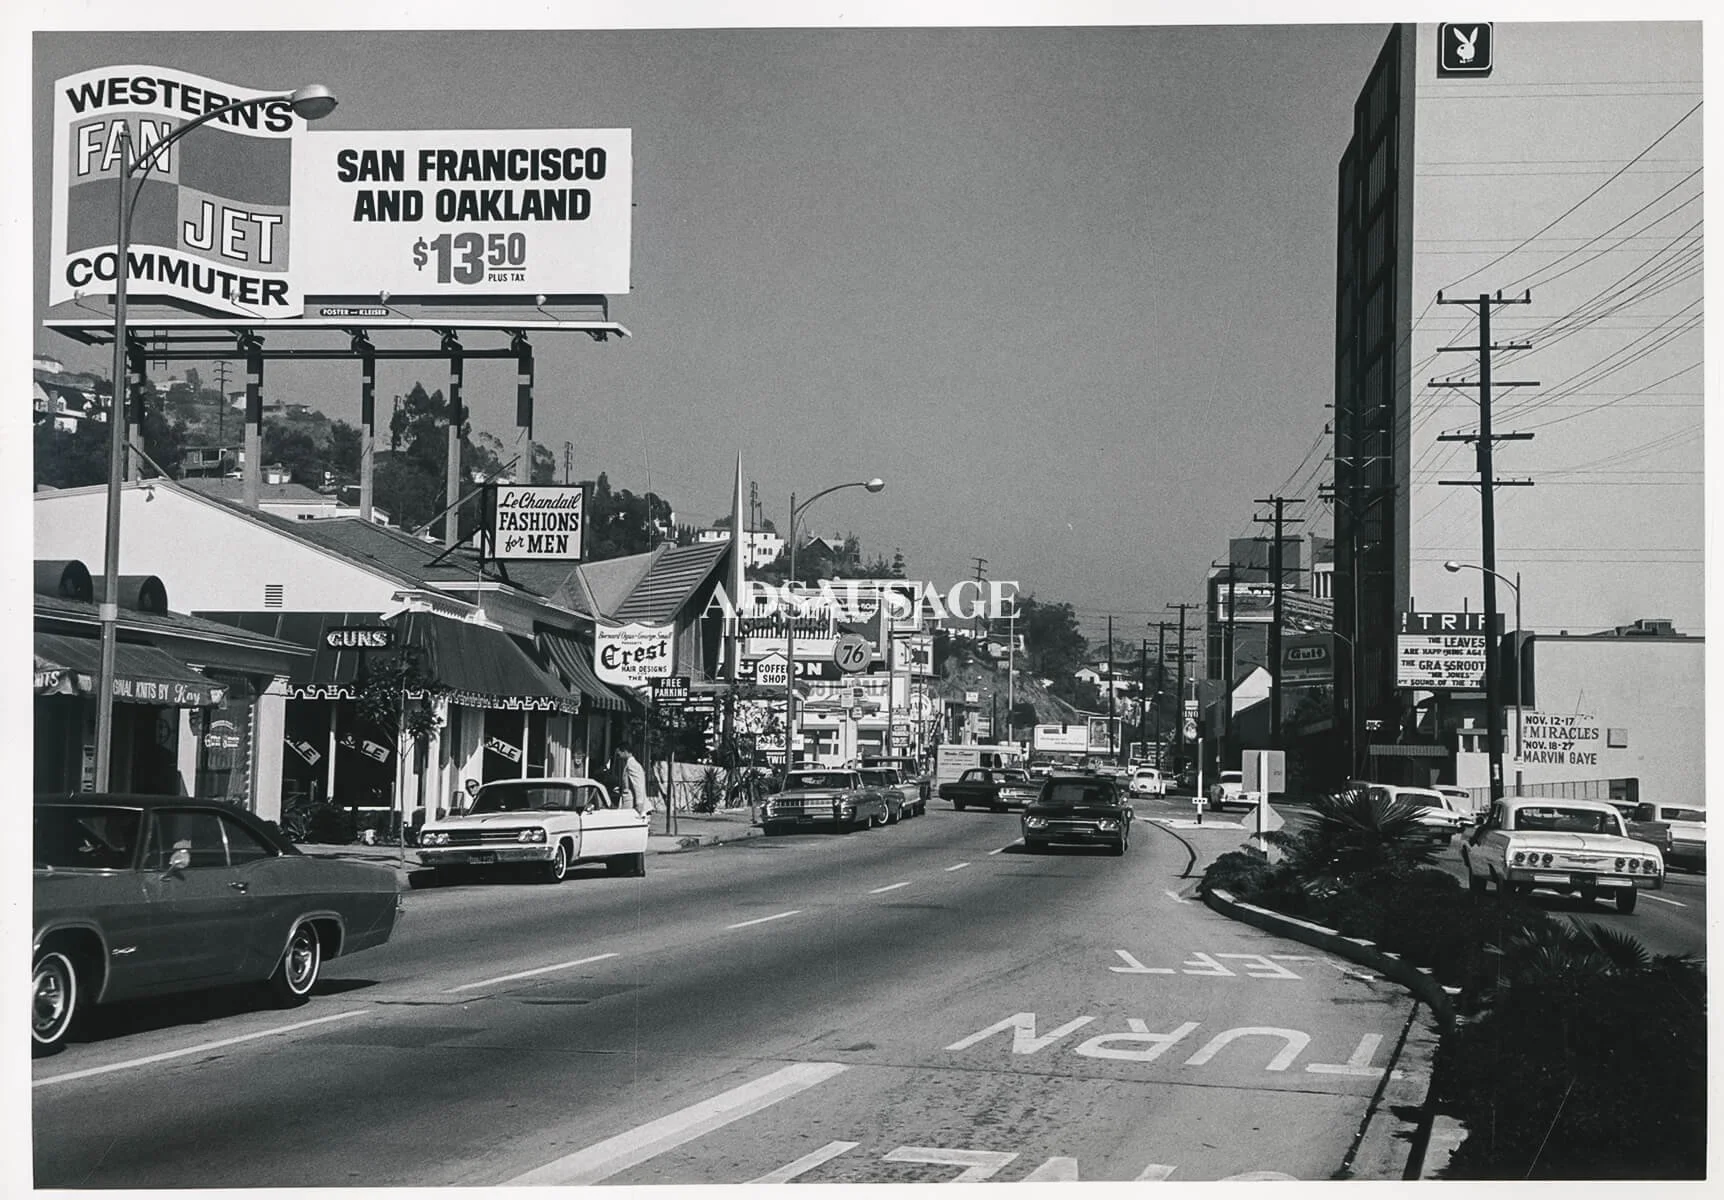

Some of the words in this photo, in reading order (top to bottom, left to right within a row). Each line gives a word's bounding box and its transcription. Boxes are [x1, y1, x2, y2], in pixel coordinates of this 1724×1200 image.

[65, 76, 294, 132] WESTERN'S
[77, 119, 171, 176] FAN
[337, 149, 404, 183] SAN
[418, 147, 607, 182] FRANCISCO
[353, 190, 424, 222] AND
[435, 188, 591, 222] OAKLAND
[183, 200, 283, 264] JET
[66, 252, 289, 306] COMMUTER
[488, 273, 508, 282] PLUS
[511, 273, 526, 282] TAX
[499, 512, 579, 532] FASHIONS
[505, 535, 524, 553] for
[527, 534, 569, 553] MEN
[327, 630, 388, 647] GUNS
[1444, 637, 1485, 648] LEAVES
[601, 640, 668, 670] Crest
[842, 644, 865, 665] 76
[758, 664, 787, 673] COFFE
[1419, 660, 1485, 671] GRASSROOT
[661, 678, 681, 688] FREE
[762, 674, 786, 684] SHOP
[135, 681, 157, 699] KNITS
[158, 683, 169, 700] BY
[654, 687, 688, 697] PARKING
[1525, 716, 1548, 725] NOV.
[1529, 726, 1599, 740] MIRACLES
[1525, 740, 1547, 749] NOV.
[1523, 750, 1564, 764] MARVIN
[1569, 752, 1597, 765] GAYE
[943, 1012, 1403, 1079] TURN
